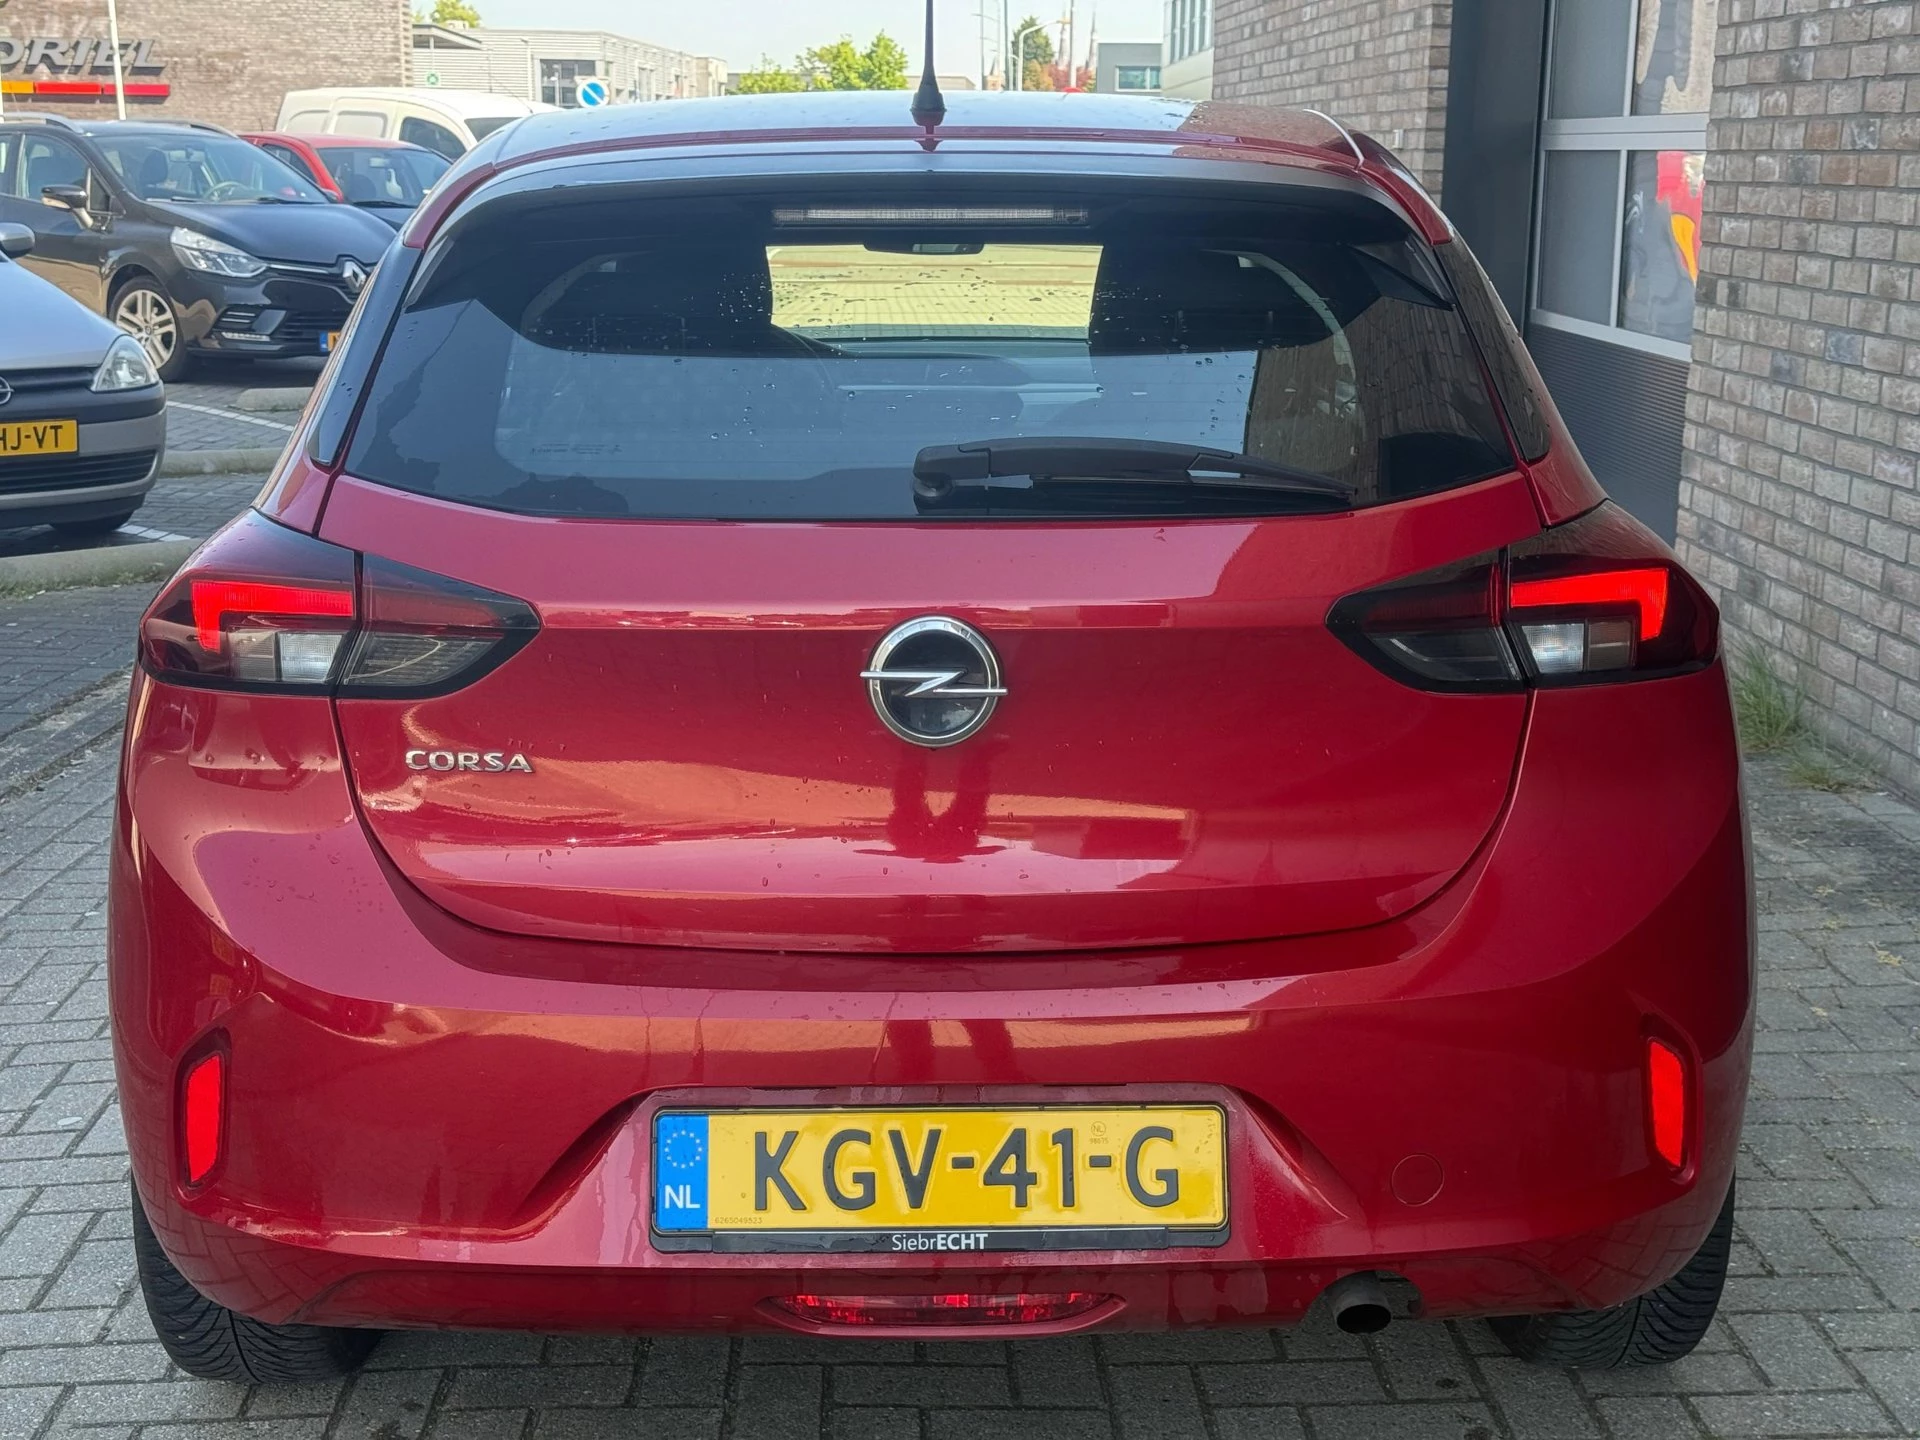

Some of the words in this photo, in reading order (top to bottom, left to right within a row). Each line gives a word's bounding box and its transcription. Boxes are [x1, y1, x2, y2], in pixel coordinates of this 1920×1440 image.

[405, 750, 533, 773] CORSA
[754, 1125, 1180, 1212] KGV-41-G
[664, 1184, 701, 1209] NL
[891, 1233, 989, 1251] SiebrECHT
